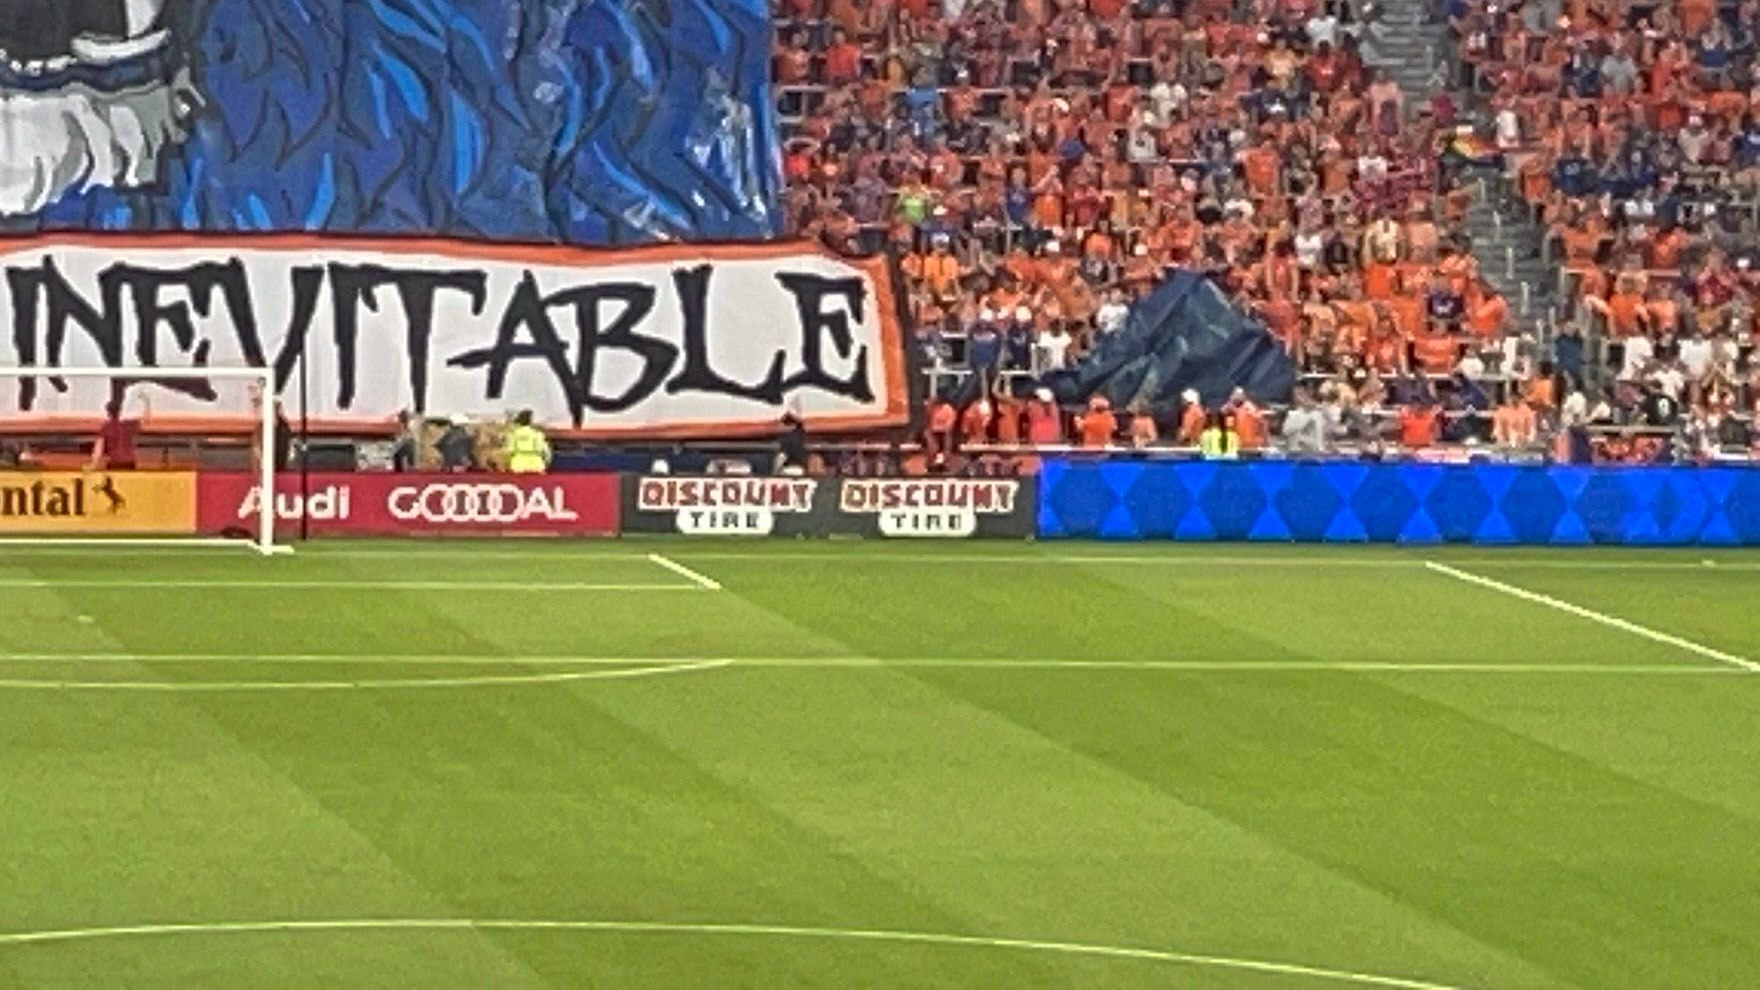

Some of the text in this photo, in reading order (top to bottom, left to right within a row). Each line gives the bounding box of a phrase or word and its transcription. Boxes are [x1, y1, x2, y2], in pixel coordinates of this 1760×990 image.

[6, 255, 874, 426] INEVITABLE
[238, 484, 350, 519] Audi
[640, 479, 816, 511] DISCOUNT
[841, 480, 1019, 512] DISCOUNT
[690, 512, 759, 529] TIRE
[890, 514, 963, 531] TIRE
